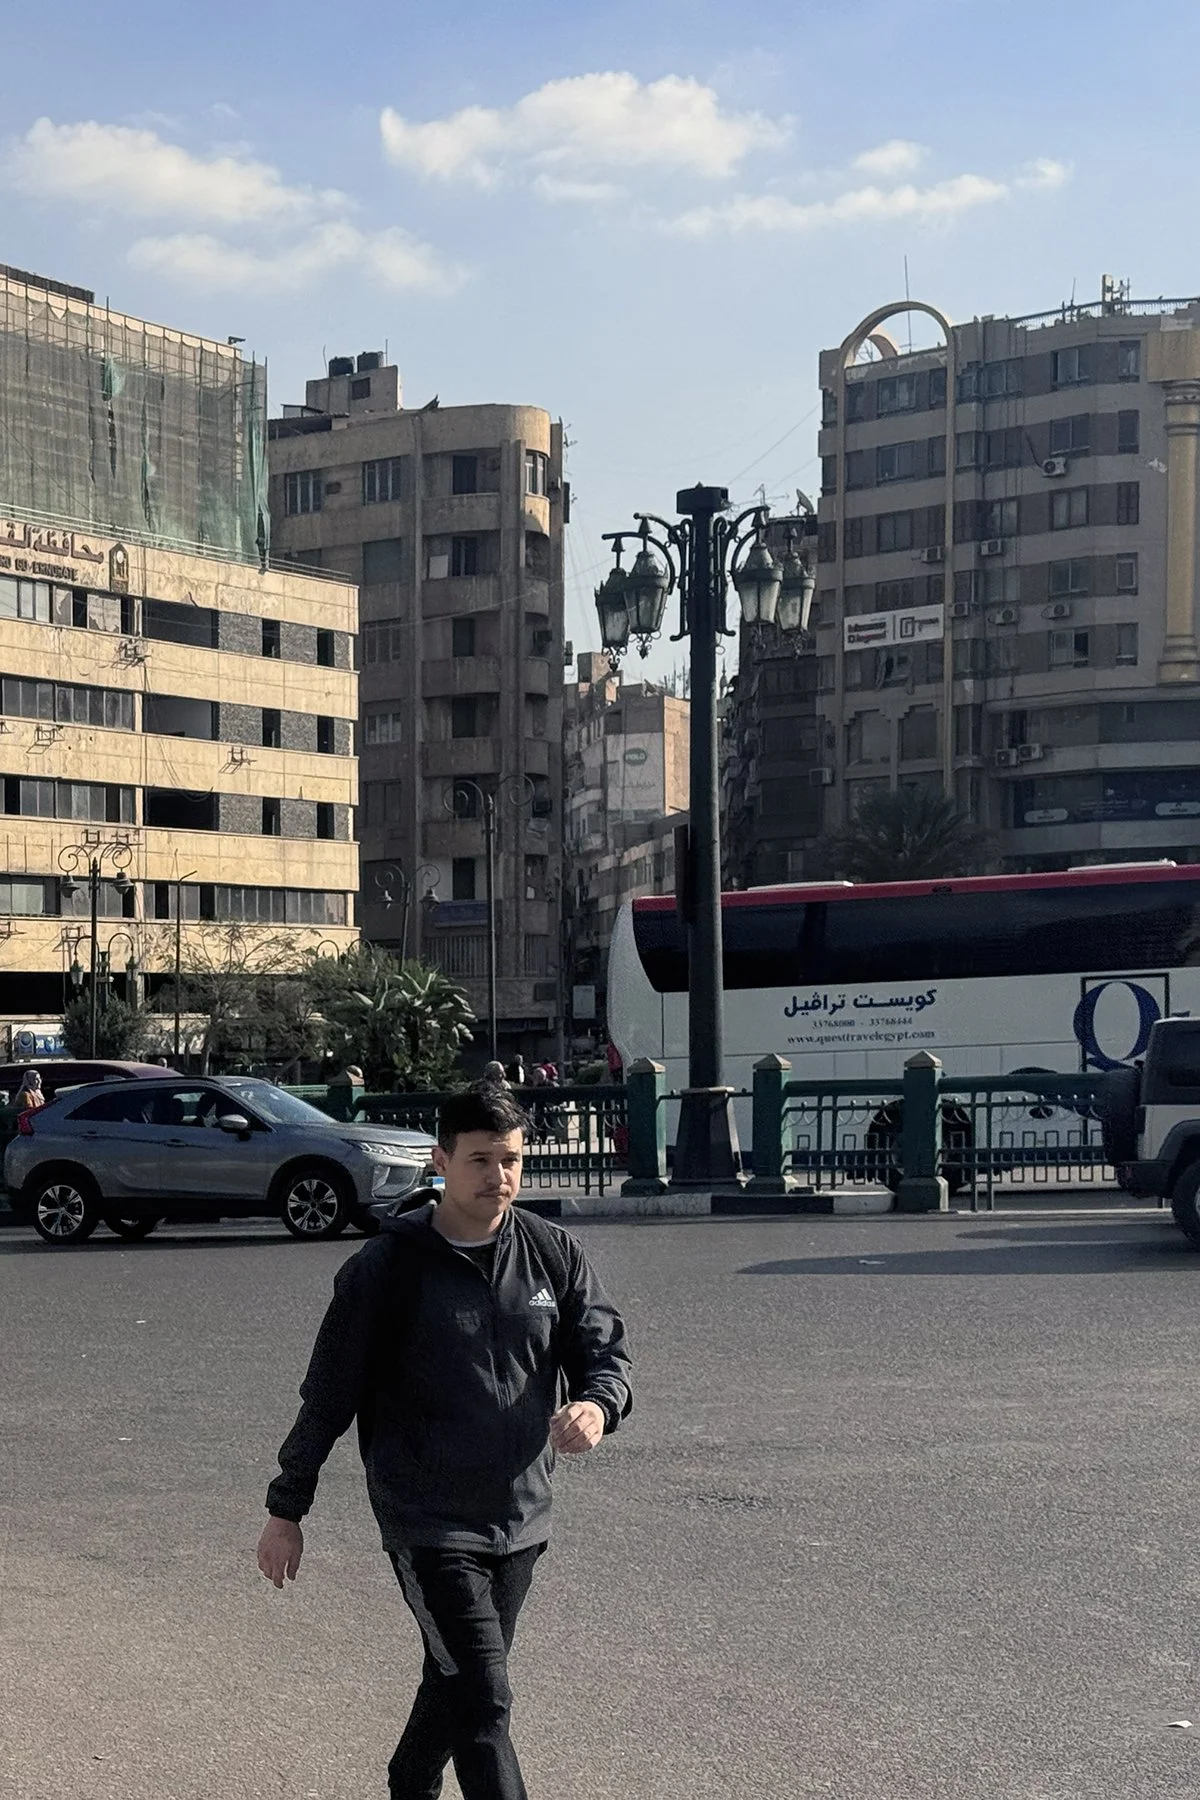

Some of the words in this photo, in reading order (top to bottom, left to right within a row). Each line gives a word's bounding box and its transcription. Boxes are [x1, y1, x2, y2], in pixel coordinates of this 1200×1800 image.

[31, 526, 104, 564] محافظة
[15, 558, 79, 581] GOERNORATE
[853, 988, 937, 1012] كويست
[1073, 980, 1161, 1073] Q
